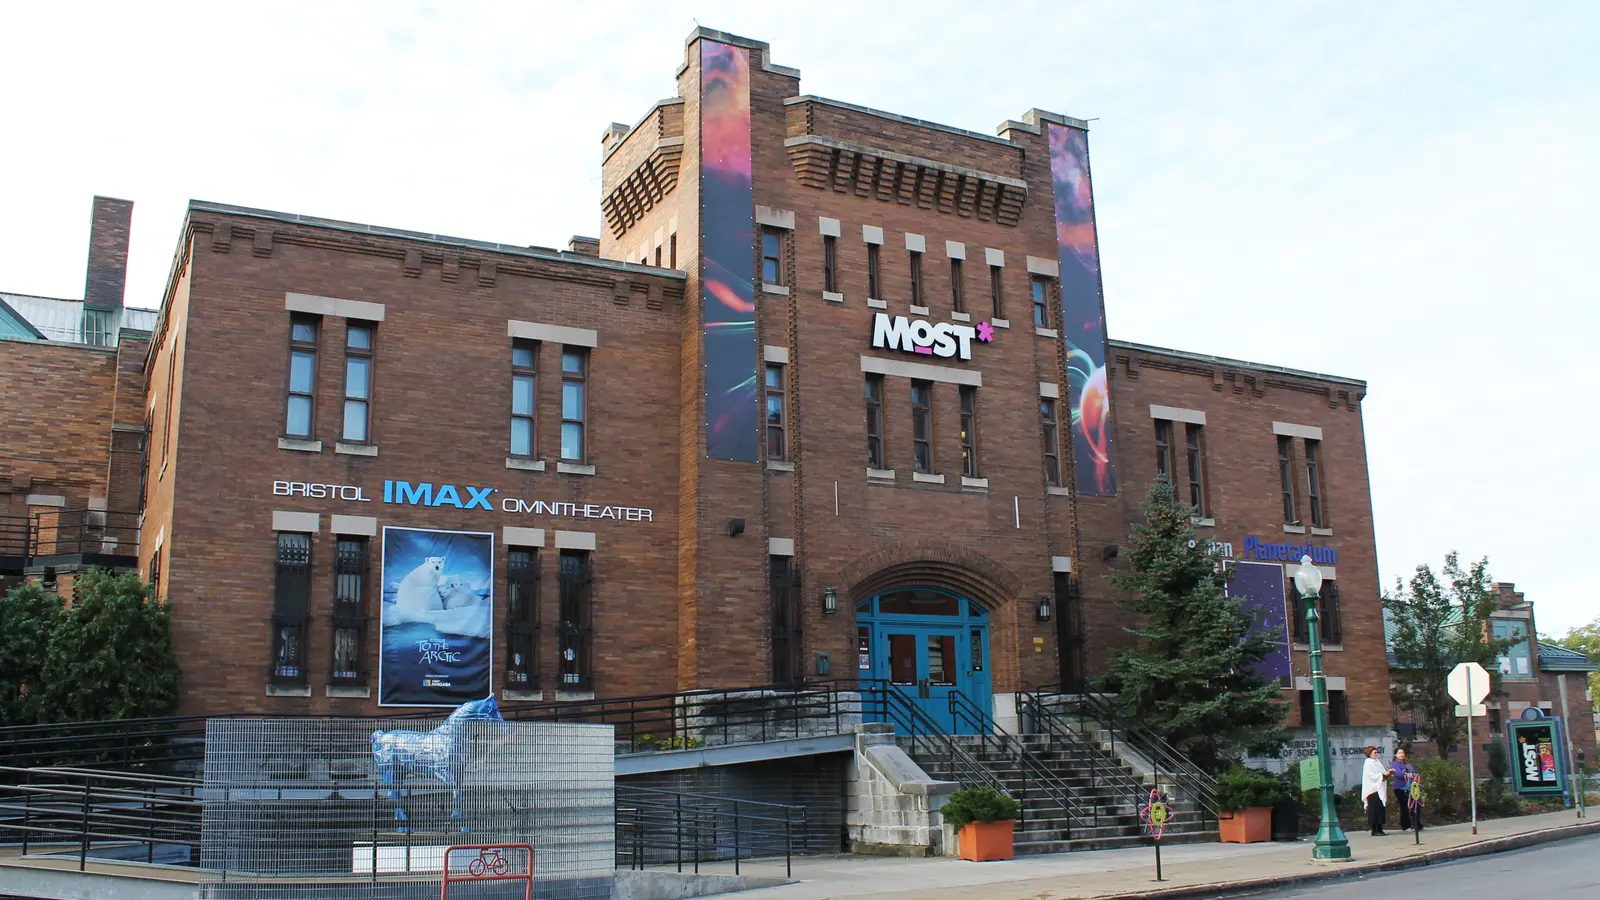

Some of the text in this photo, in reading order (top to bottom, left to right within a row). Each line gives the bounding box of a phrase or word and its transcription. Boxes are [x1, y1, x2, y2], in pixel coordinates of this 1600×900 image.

[872, 312, 976, 360] MOST
[273, 479, 653, 522] BRISTOL IMAX OMNITHEATER
[1244, 535, 1337, 564] Planetarium
[416, 640, 449, 652] TO THE
[419, 651, 460, 664] ARCTIC
[1283, 749, 1293, 757] OF
[1297, 748, 1318, 757] SCIEN
[1331, 747, 1337, 756] &
[1522, 743, 1539, 780] MOST
